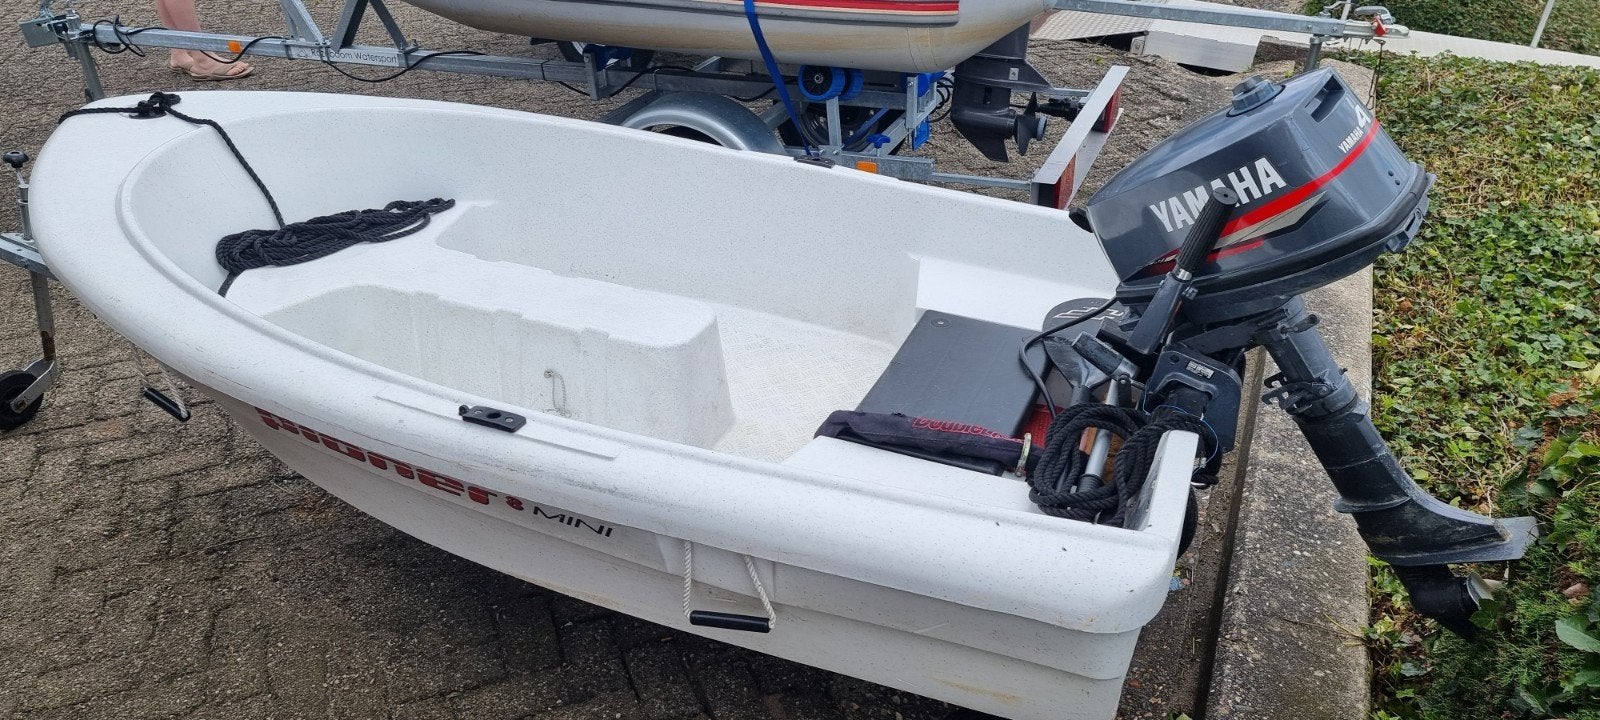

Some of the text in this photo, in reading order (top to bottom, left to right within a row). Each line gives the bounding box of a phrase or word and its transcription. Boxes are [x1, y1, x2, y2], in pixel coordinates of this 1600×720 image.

[354, 51, 397, 64] Watersport
[1338, 104, 1372, 154] YAMAHA 4
[533, 506, 613, 538] MINI
